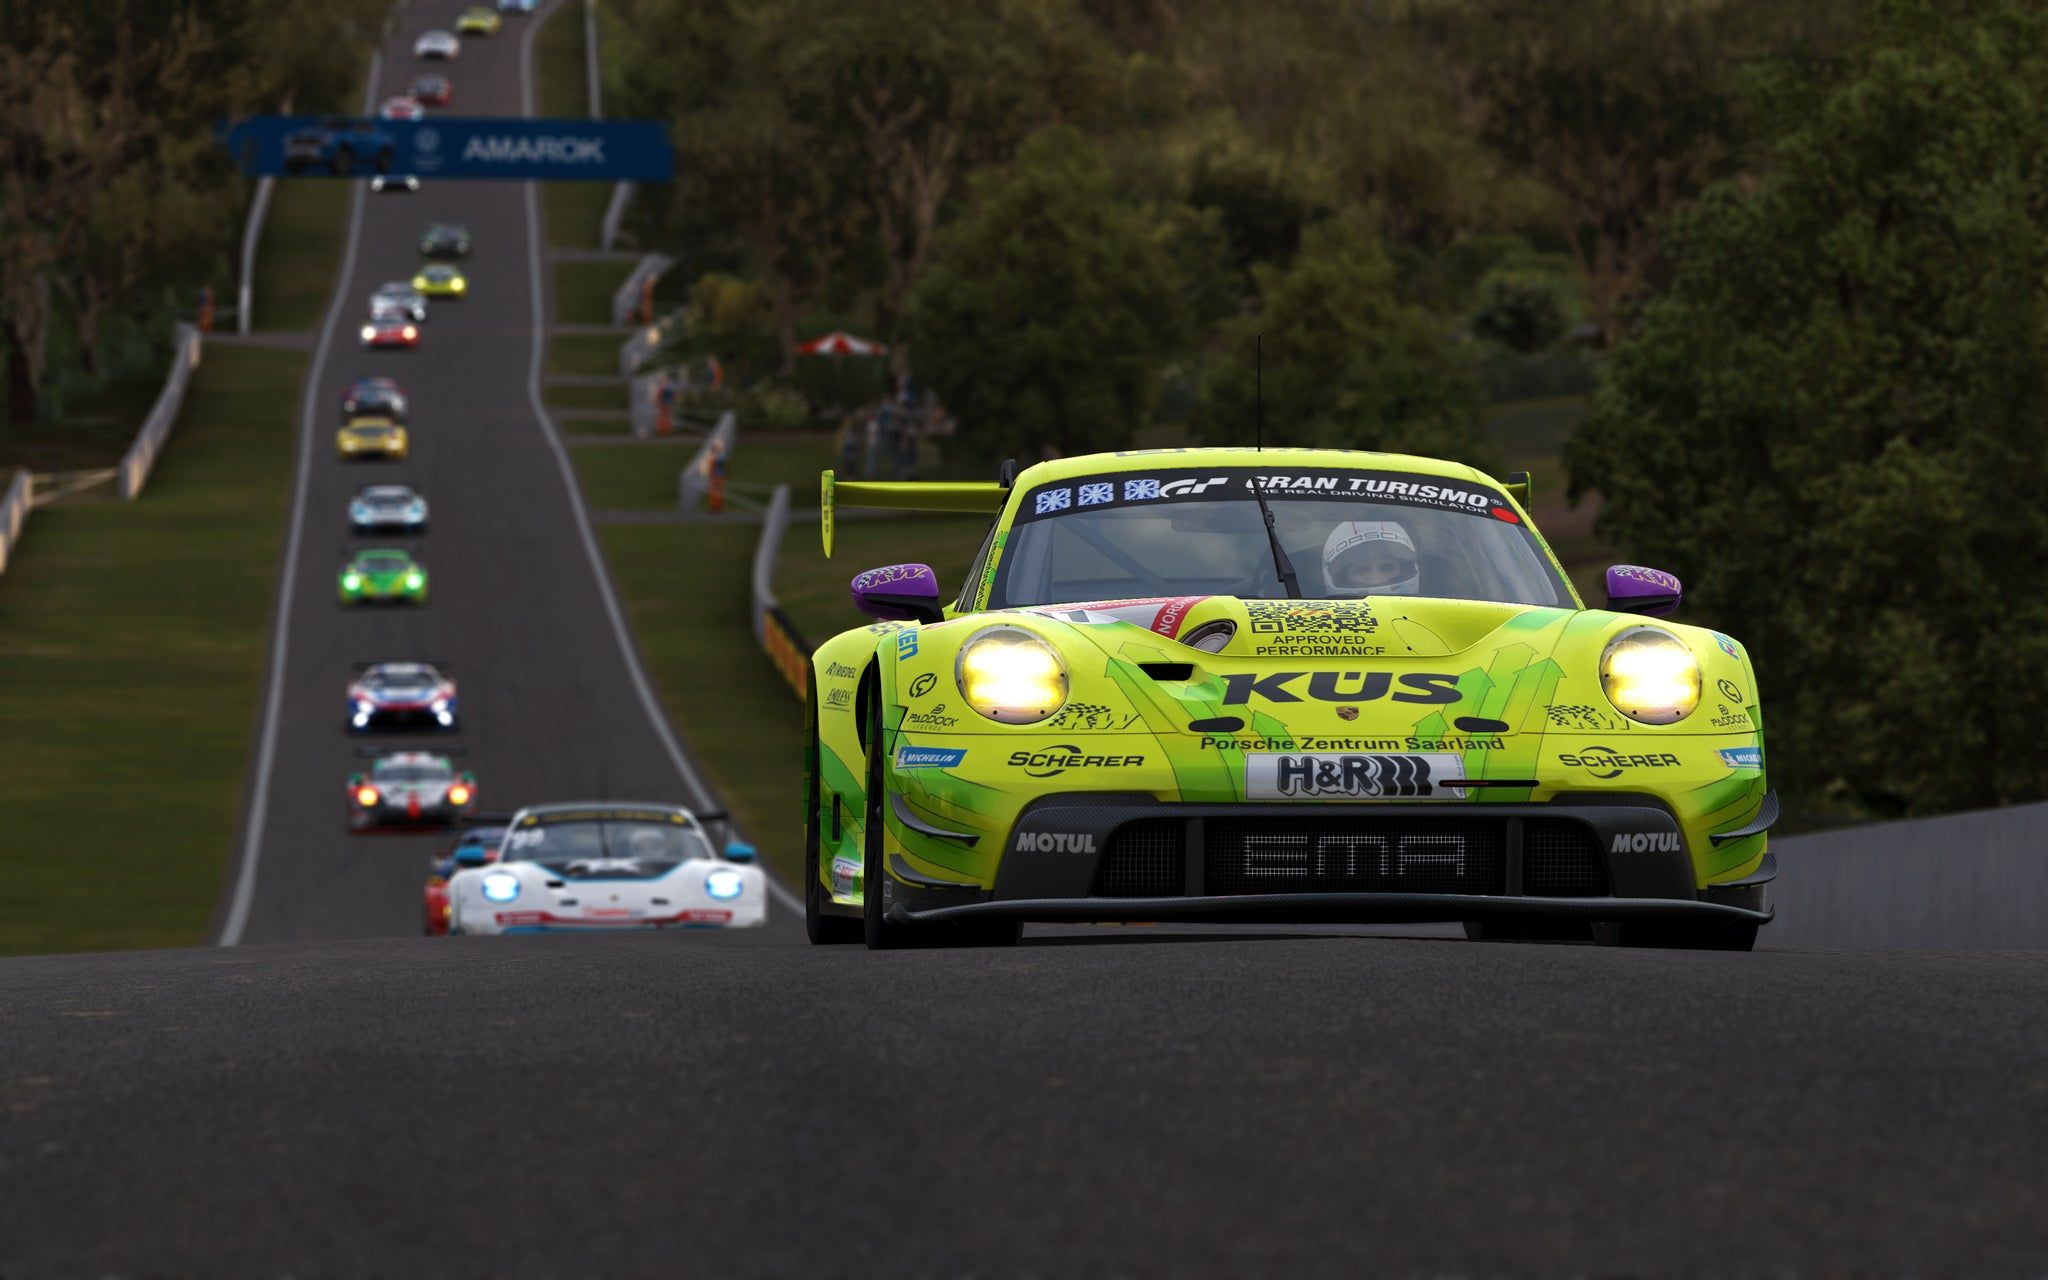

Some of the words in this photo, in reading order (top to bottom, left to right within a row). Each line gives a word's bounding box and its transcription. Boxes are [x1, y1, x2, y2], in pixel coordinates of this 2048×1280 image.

[463, 136, 605, 164] AMAROK
[1246, 476, 1339, 490] GRAN
[1330, 490, 1395, 500] DRIVING
[1398, 495, 1488, 515] SIMULATOR
[1273, 635, 1366, 645] APPROVED
[1222, 671, 1464, 705] KÜS
[907, 713, 959, 727] PADDOCK
[1200, 736, 1295, 750] Porsche
[1300, 736, 1400, 750] Zentrum
[1404, 736, 1506, 750] Saarland
[905, 752, 957, 763] MICHELIN
[1007, 751, 1146, 768] SCHERER
[1557, 752, 1682, 768] SCHERER
[1278, 755, 1380, 795] H&R
[1016, 832, 1097, 854] MOTUL
[1610, 832, 1682, 853] MOTUL
